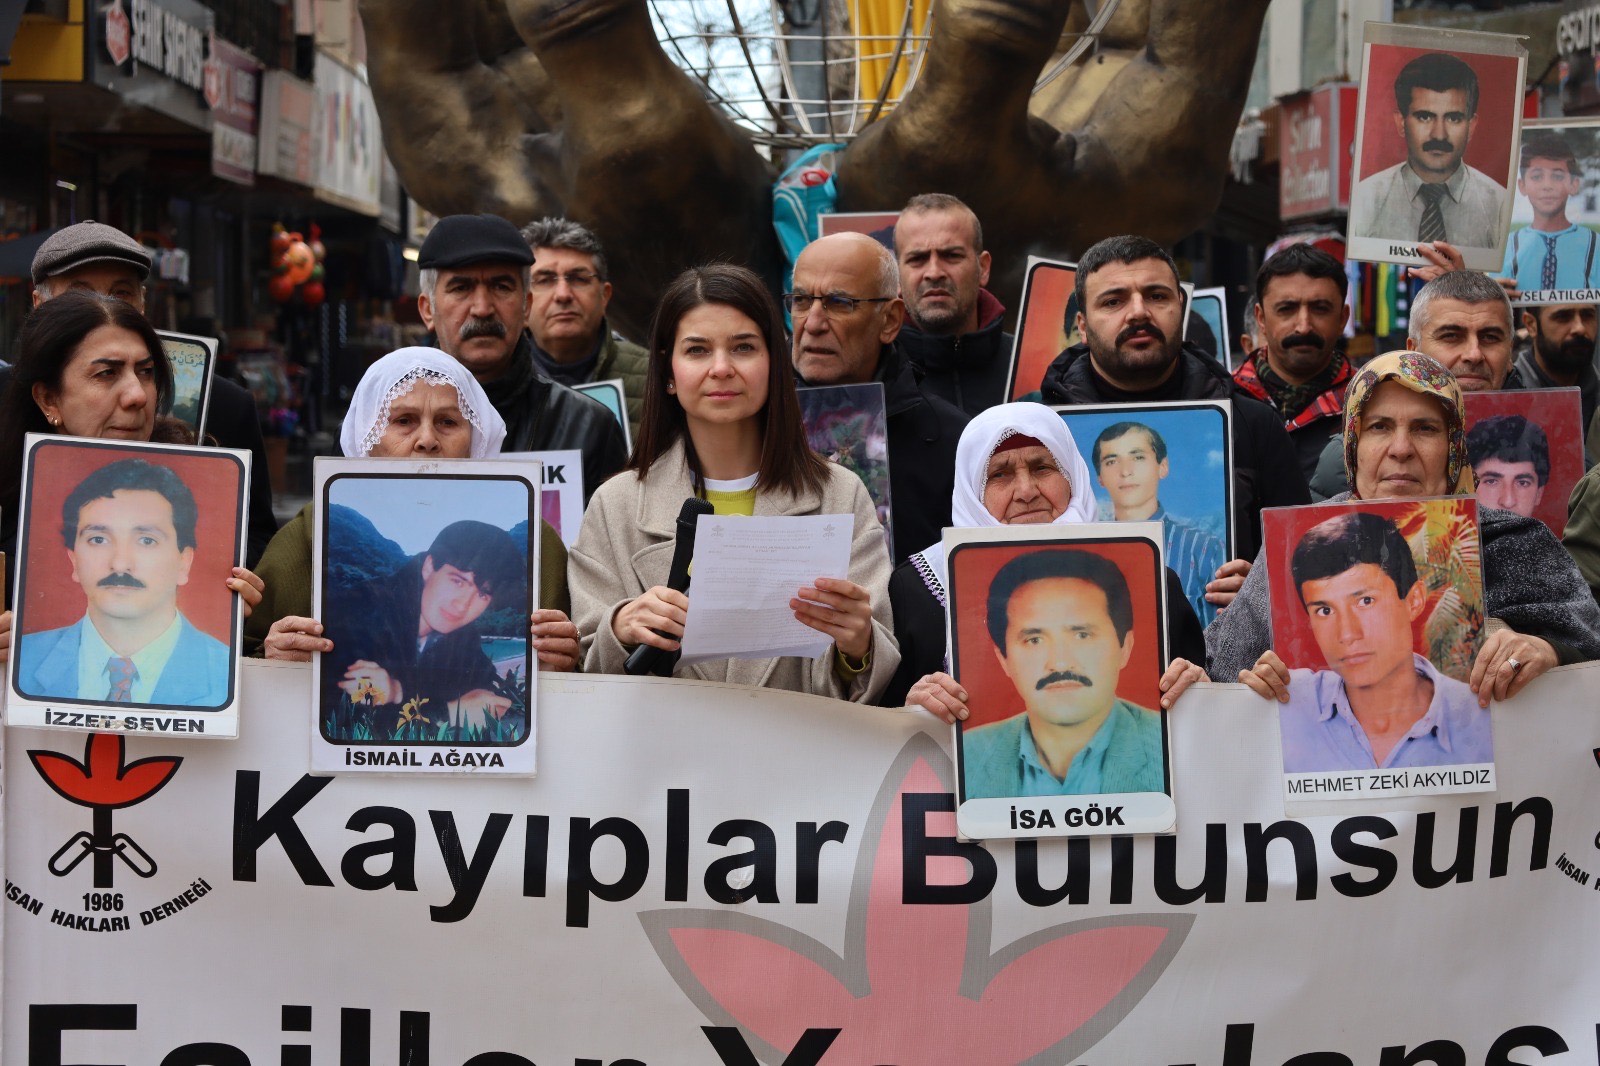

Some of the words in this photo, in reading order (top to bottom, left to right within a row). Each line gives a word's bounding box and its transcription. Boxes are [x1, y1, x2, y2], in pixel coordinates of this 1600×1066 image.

[45, 707, 116, 727] İZZET
[123, 716, 205, 733] SEVEN
[345, 747, 423, 766] İSMAİL
[429, 749, 505, 767] AĞAYA
[1287, 776, 1365, 794] MEHMET
[1369, 771, 1409, 790] ZEKİ
[1413, 769, 1491, 788] AKYILDIZ
[1010, 805, 1056, 829] İSA
[1064, 803, 1125, 827] GÖK
[233, 770, 849, 928] Kayıplar
[901, 793, 1554, 906] Bulunsun
[1554, 852, 1590, 886] İNSAN
[50, 908, 131, 933] HAKLARI
[139, 877, 213, 926] DERNEĞİ
[82, 893, 124, 912] 1986
